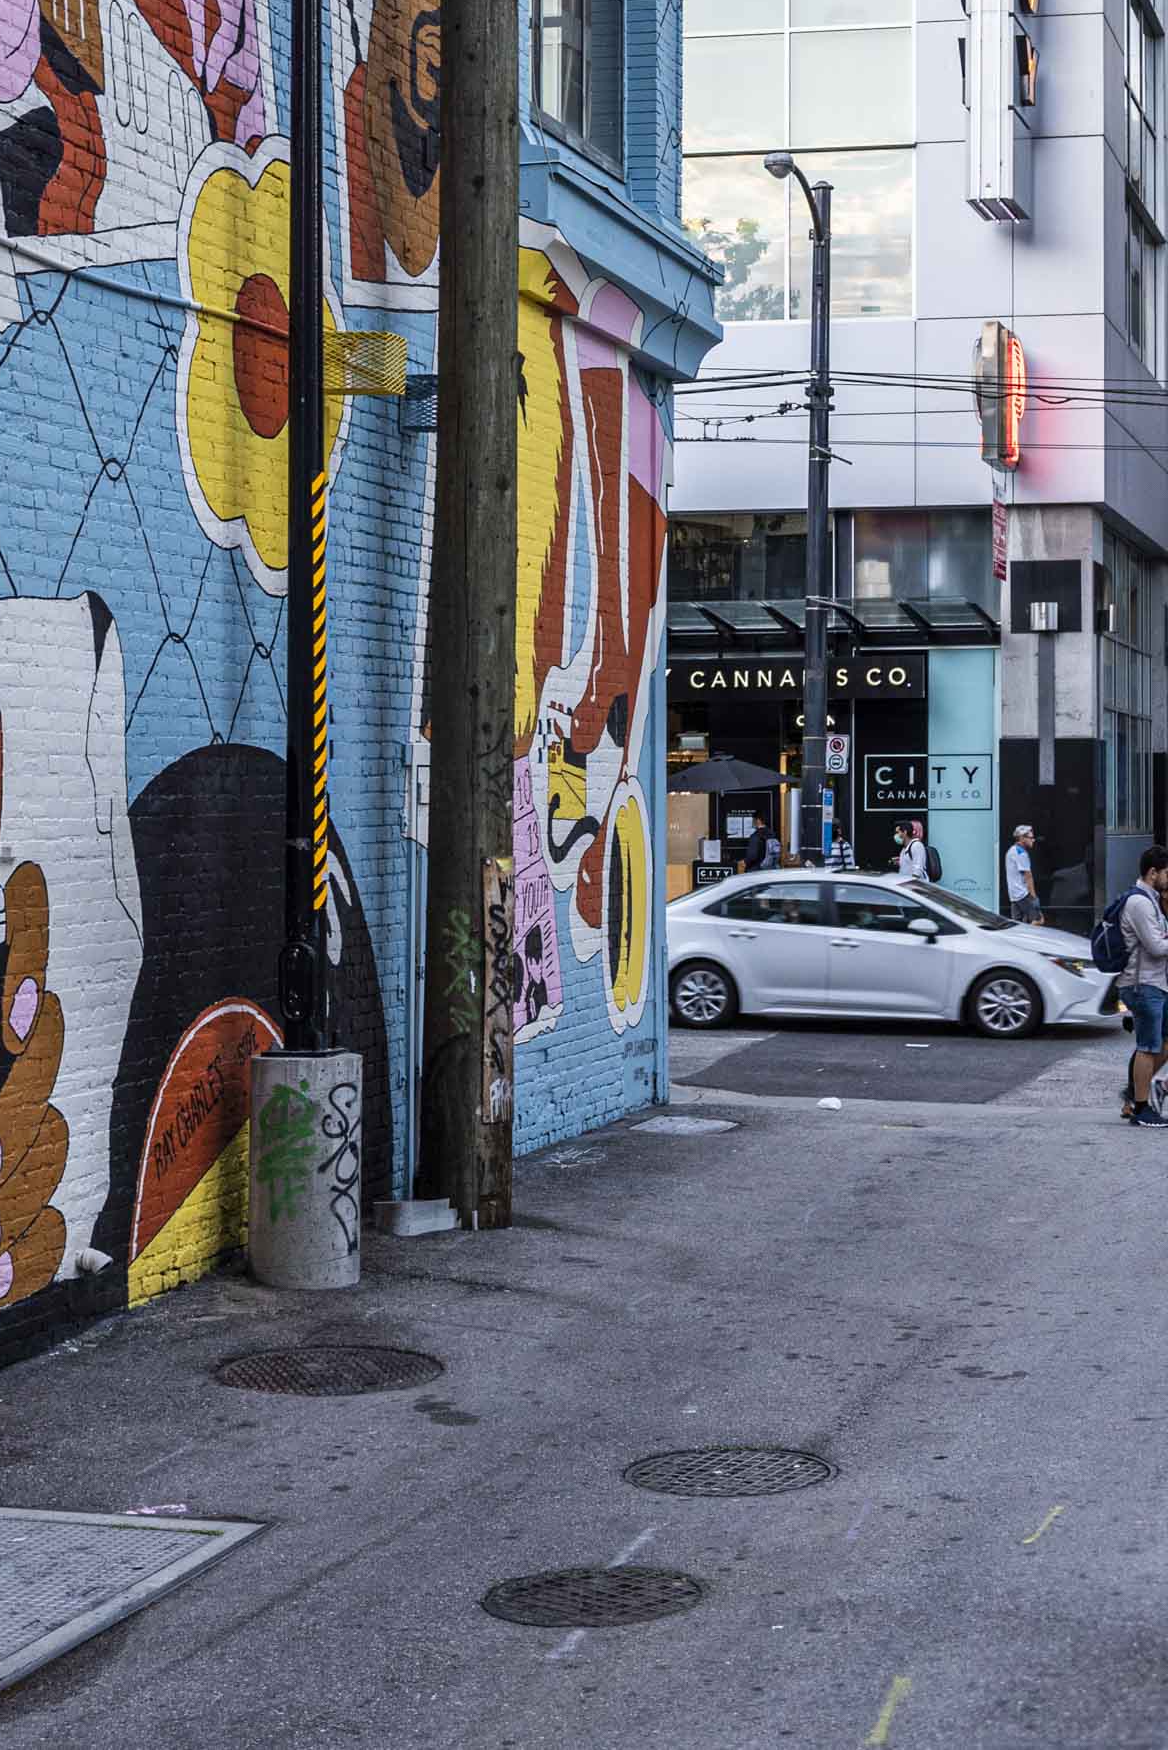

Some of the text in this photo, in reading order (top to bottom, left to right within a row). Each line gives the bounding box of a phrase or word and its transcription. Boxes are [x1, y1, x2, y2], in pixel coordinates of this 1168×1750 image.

[690, 668, 849, 688] CANNAS
[875, 766, 979, 785] CITY
[876, 790, 953, 800] CANNABIS
[700, 869, 730, 878] CITY
[521, 873, 548, 924] YOUTH
